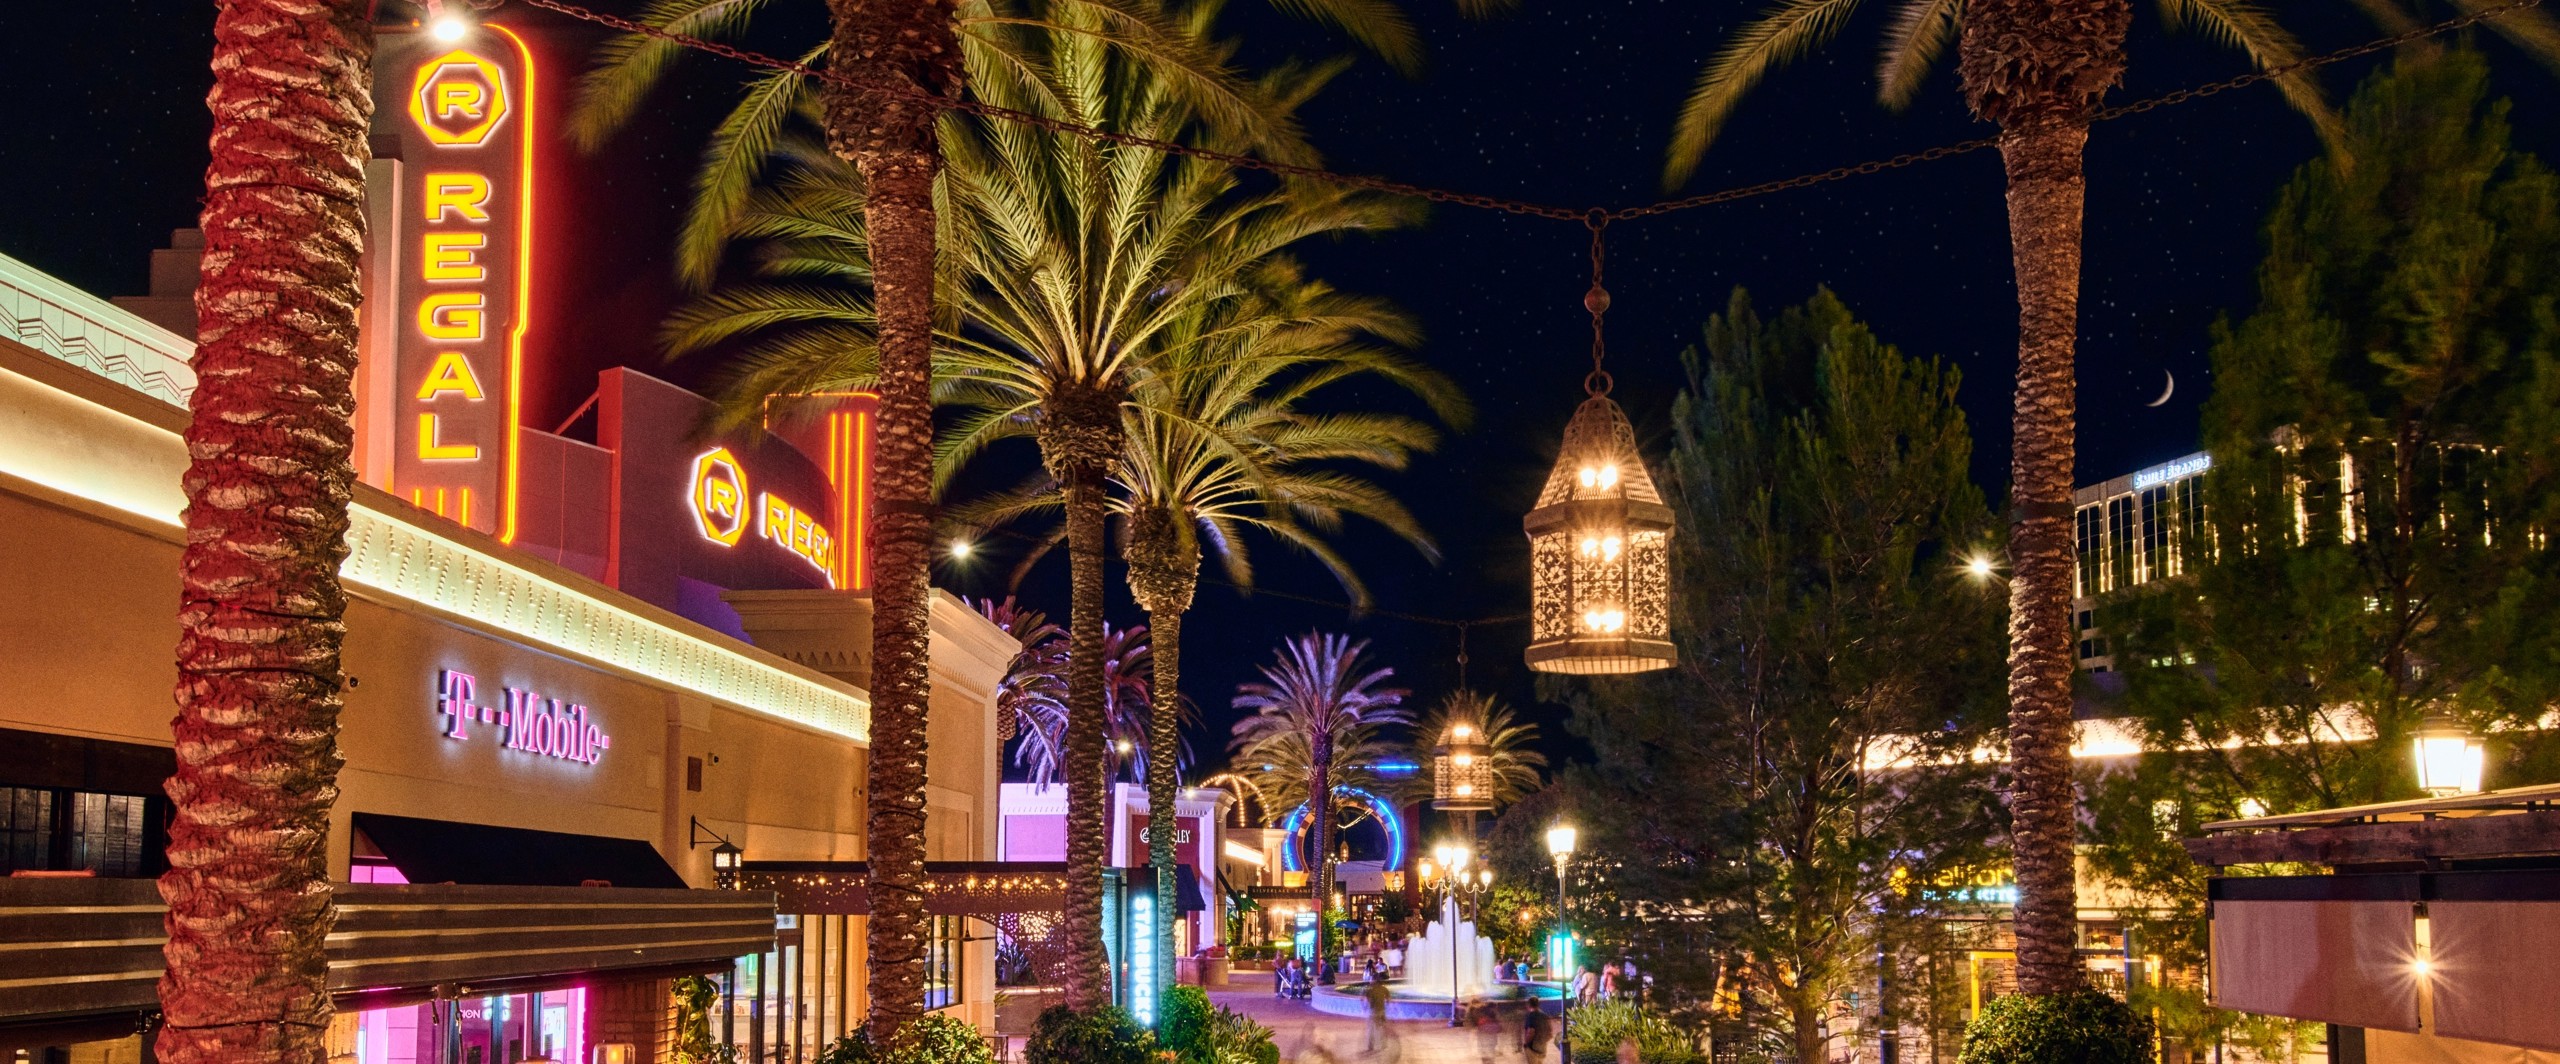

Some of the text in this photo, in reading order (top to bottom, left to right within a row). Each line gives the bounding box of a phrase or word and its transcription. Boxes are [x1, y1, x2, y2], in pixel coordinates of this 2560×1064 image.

[437, 82, 483, 116] R
[416, 172, 490, 461] REGAL
[706, 477, 738, 519] R
